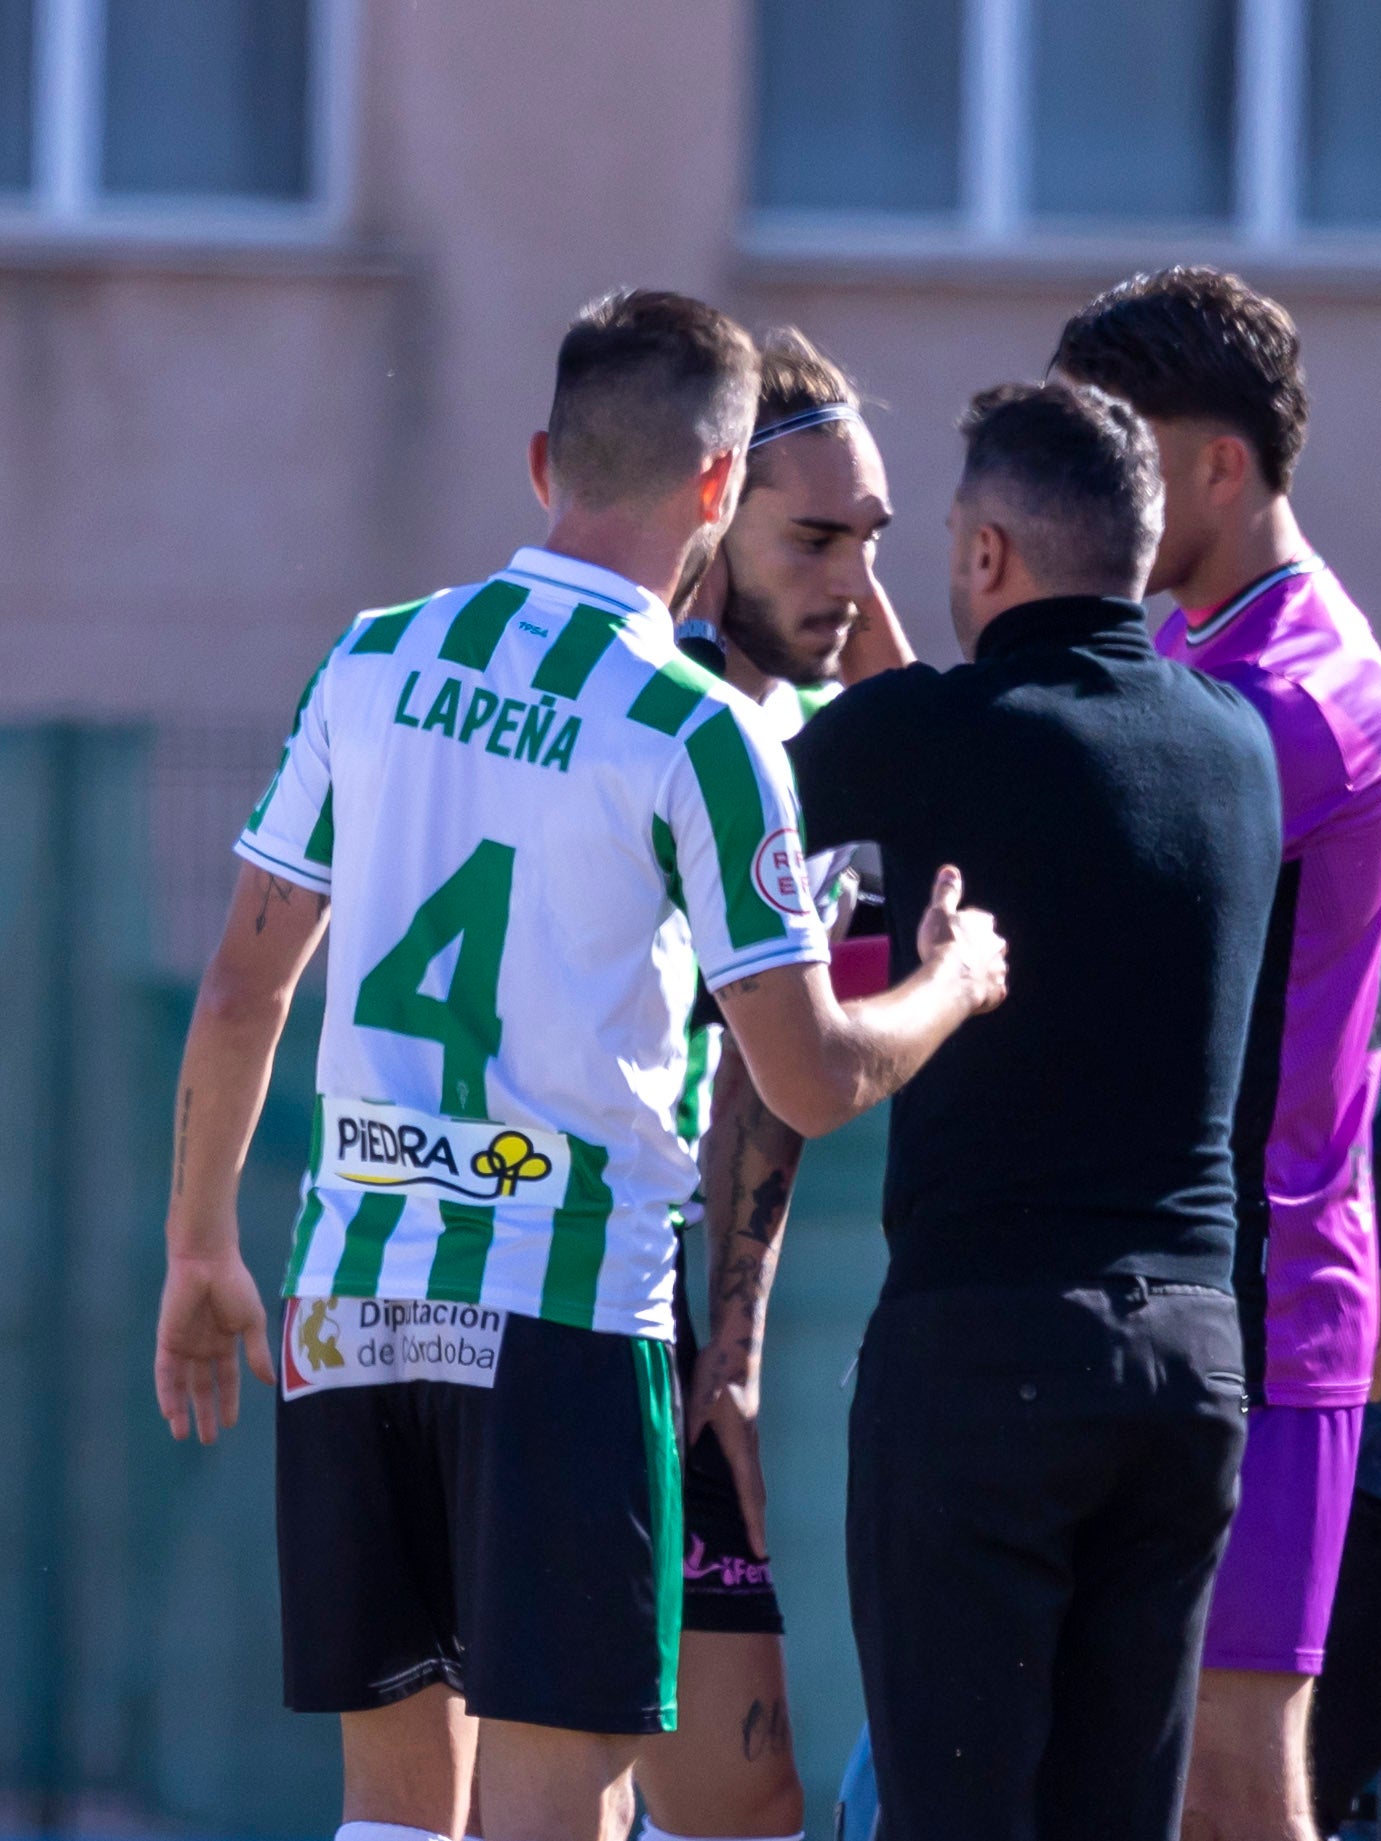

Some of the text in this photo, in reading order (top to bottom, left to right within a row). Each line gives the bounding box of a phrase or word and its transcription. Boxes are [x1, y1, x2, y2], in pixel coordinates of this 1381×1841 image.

[394, 670, 582, 774] LAPEÑA
[353, 837, 516, 1120] 4
[357, 1335, 496, 1370] de Córdoba
